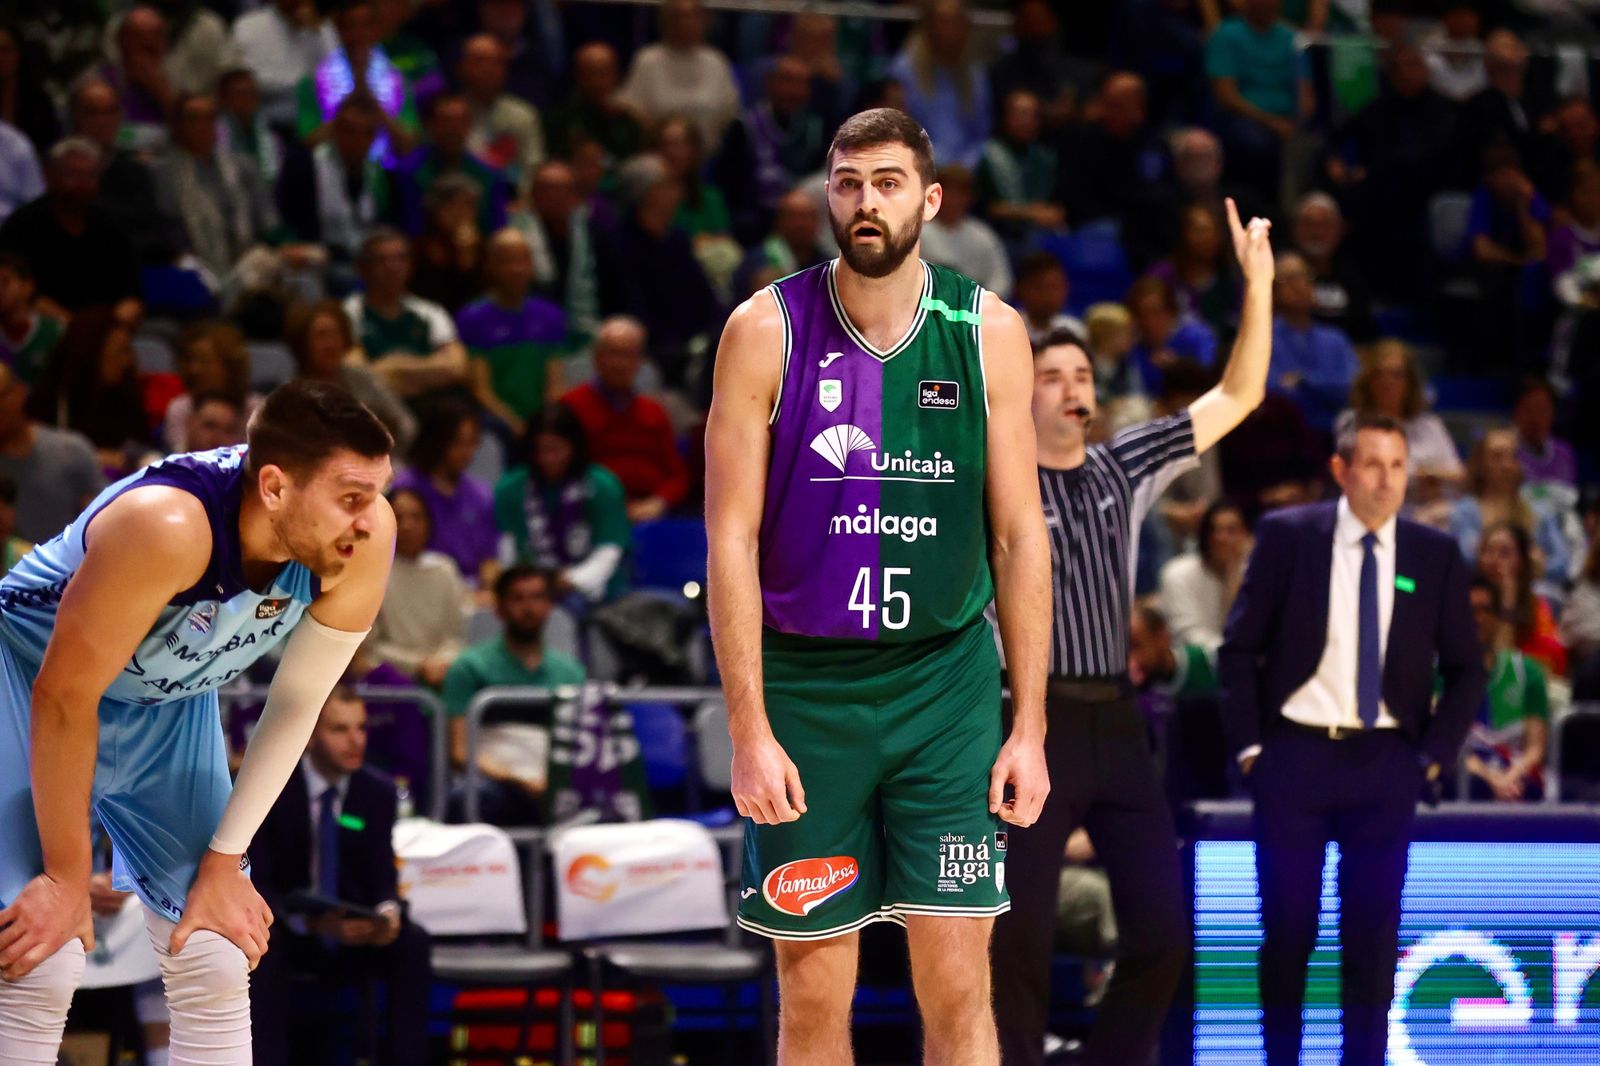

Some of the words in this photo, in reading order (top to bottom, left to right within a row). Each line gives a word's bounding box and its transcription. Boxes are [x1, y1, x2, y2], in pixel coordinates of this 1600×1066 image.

[922, 389, 938, 397] liga
[922, 397, 956, 405] endesa
[871, 450, 955, 478] Unicaja
[847, 566, 912, 630] 45
[939, 832, 965, 842] sabor
[939, 843, 946, 852] a
[948, 835, 990, 860] má
[771, 863, 855, 901] famadesa
[939, 855, 990, 884] laga
